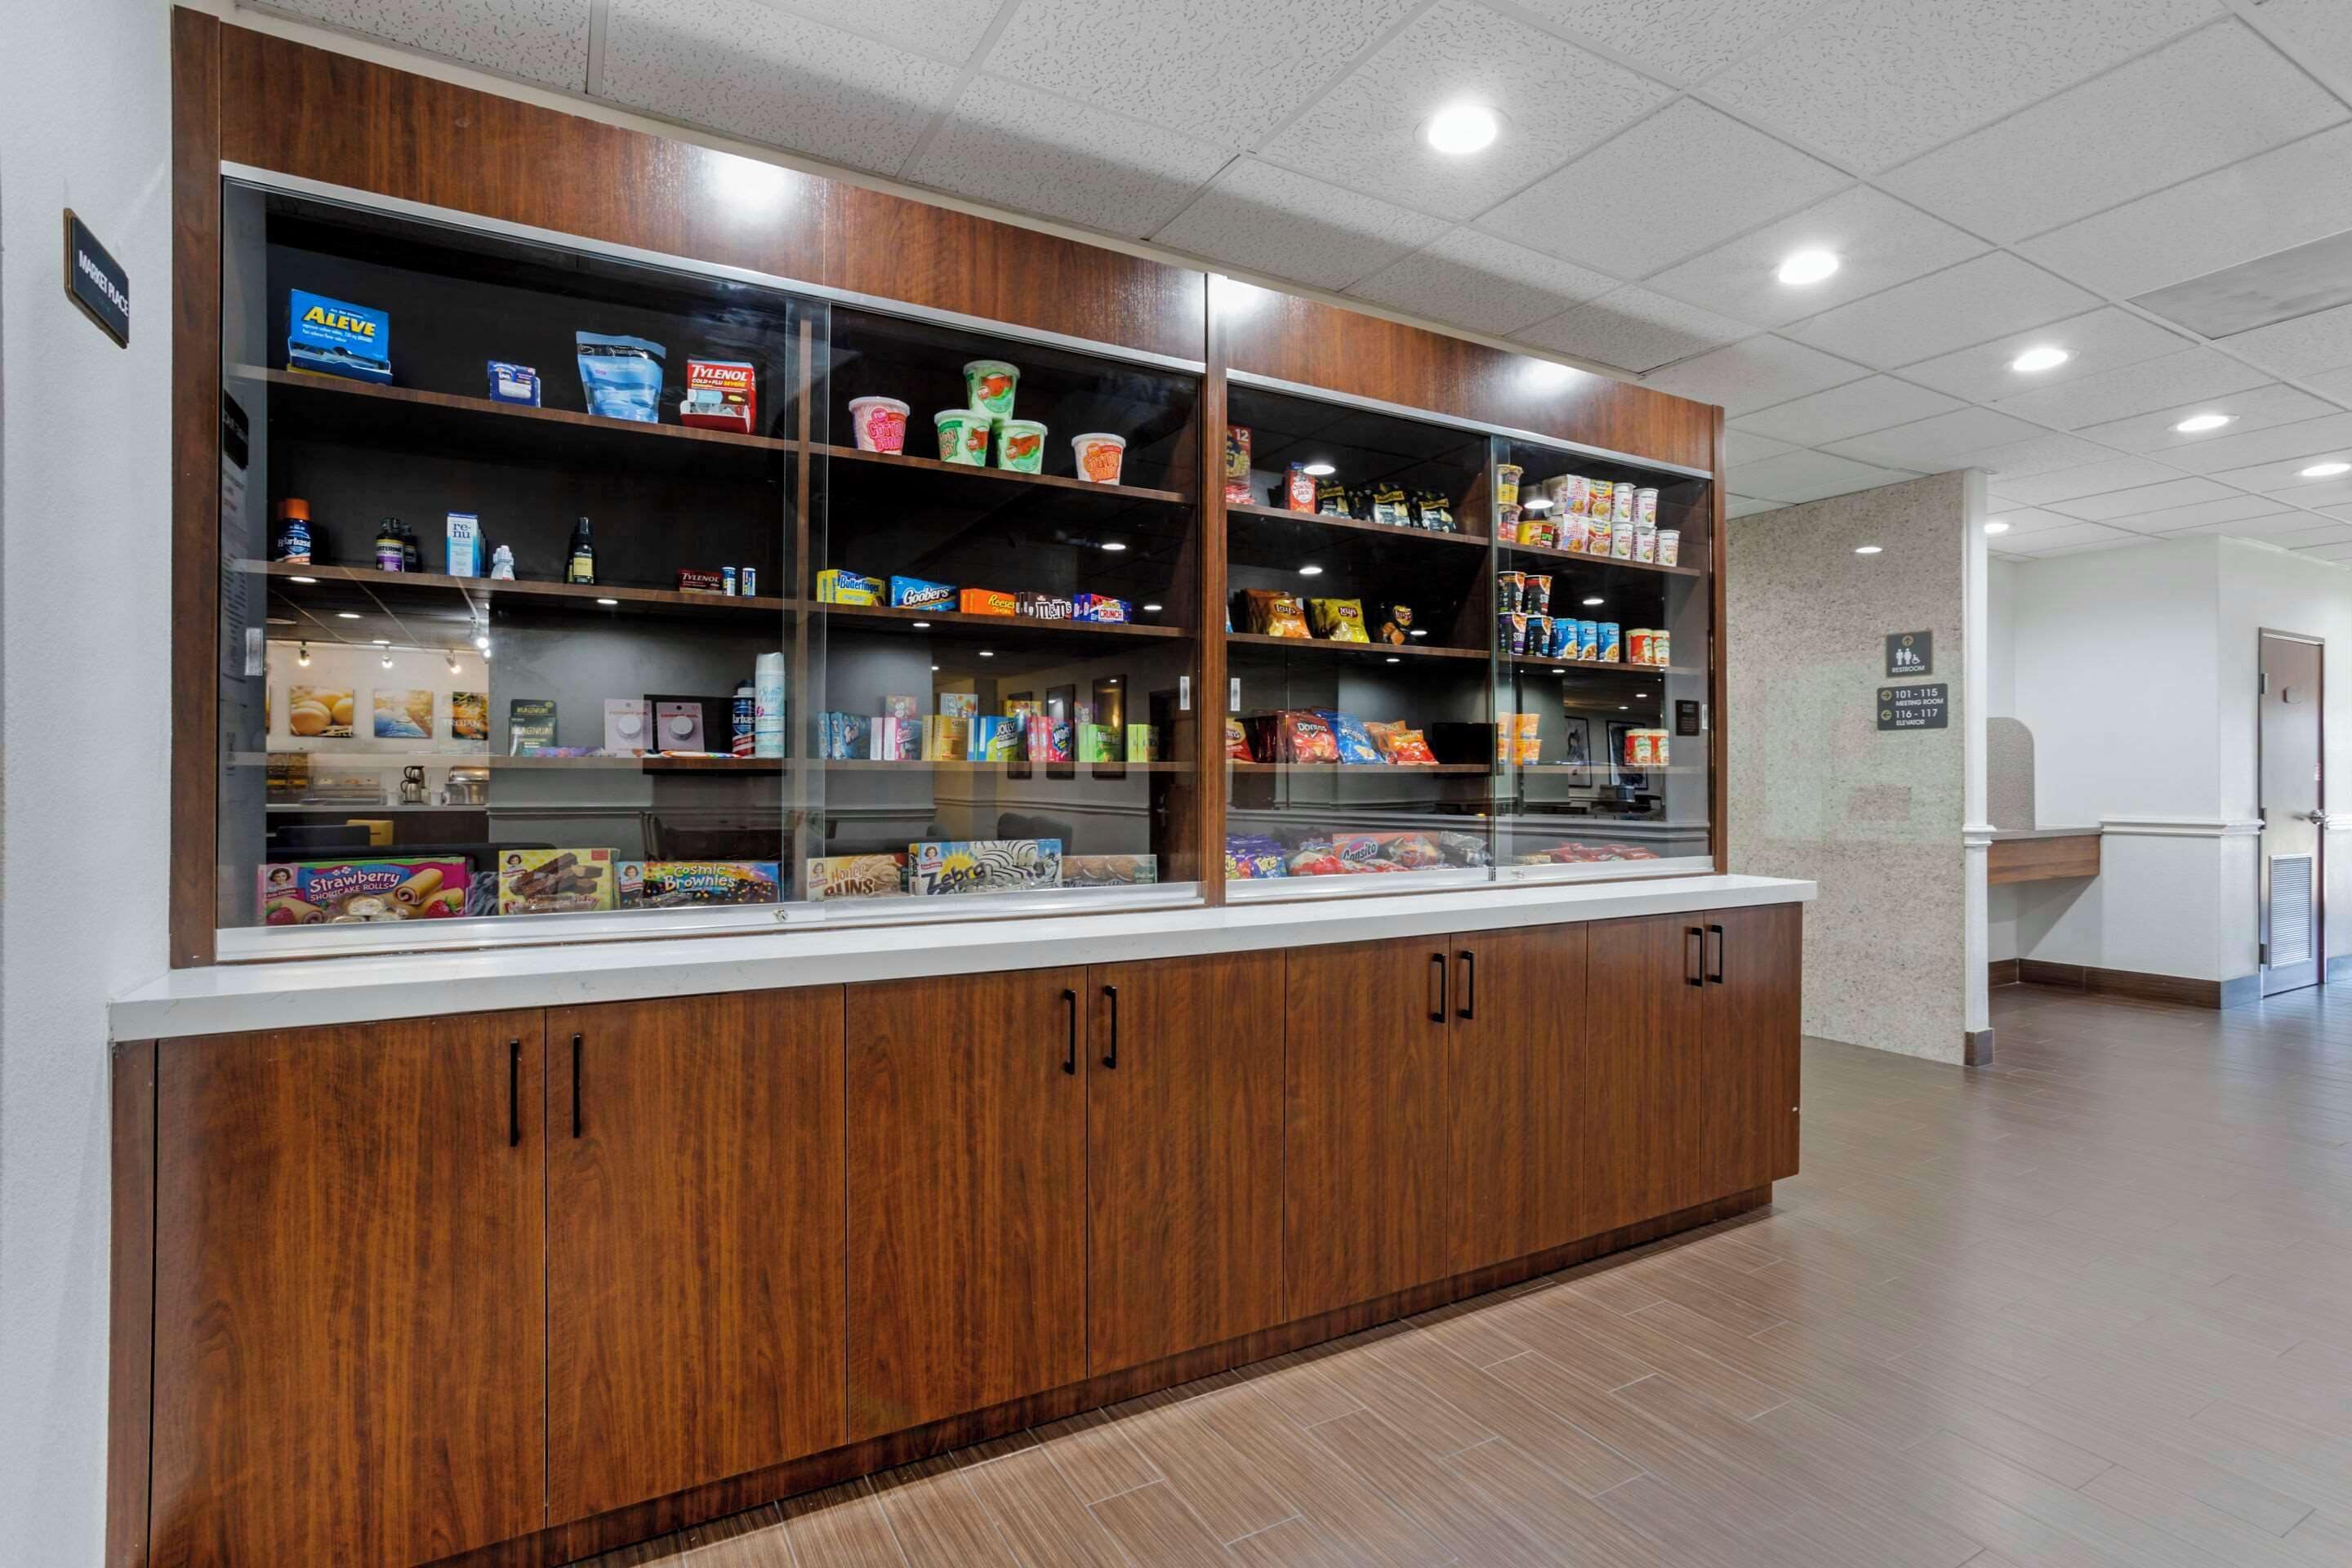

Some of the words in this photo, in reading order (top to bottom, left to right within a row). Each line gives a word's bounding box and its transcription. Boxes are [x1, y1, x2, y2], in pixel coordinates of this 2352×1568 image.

[78, 249, 108, 294] MARKET
[108, 281, 129, 317] PLACE
[302, 305, 376, 336] ALEVE
[692, 364, 749, 381] TYLENOL
[1234, 428, 1250, 442] 12
[681, 572, 719, 583] TYLENOL
[840, 574, 880, 595] Butterfinger
[903, 586, 949, 606] Goobers
[1099, 609, 1123, 619] CRUNCH
[1891, 665, 1926, 673] RESTROOM
[1895, 689, 1912, 699] 101
[1921, 688, 1939, 697] 115
[1895, 698, 1922, 706] MEETING
[1895, 710, 1913, 719] 116
[1921, 708, 1939, 718] 117
[674, 865, 726, 877] Cosmic
[921, 862, 986, 895] Zebra
[310, 870, 401, 893] Strawberry
[663, 875, 736, 893] Brownies
[310, 885, 361, 902] SHORTCAKE
